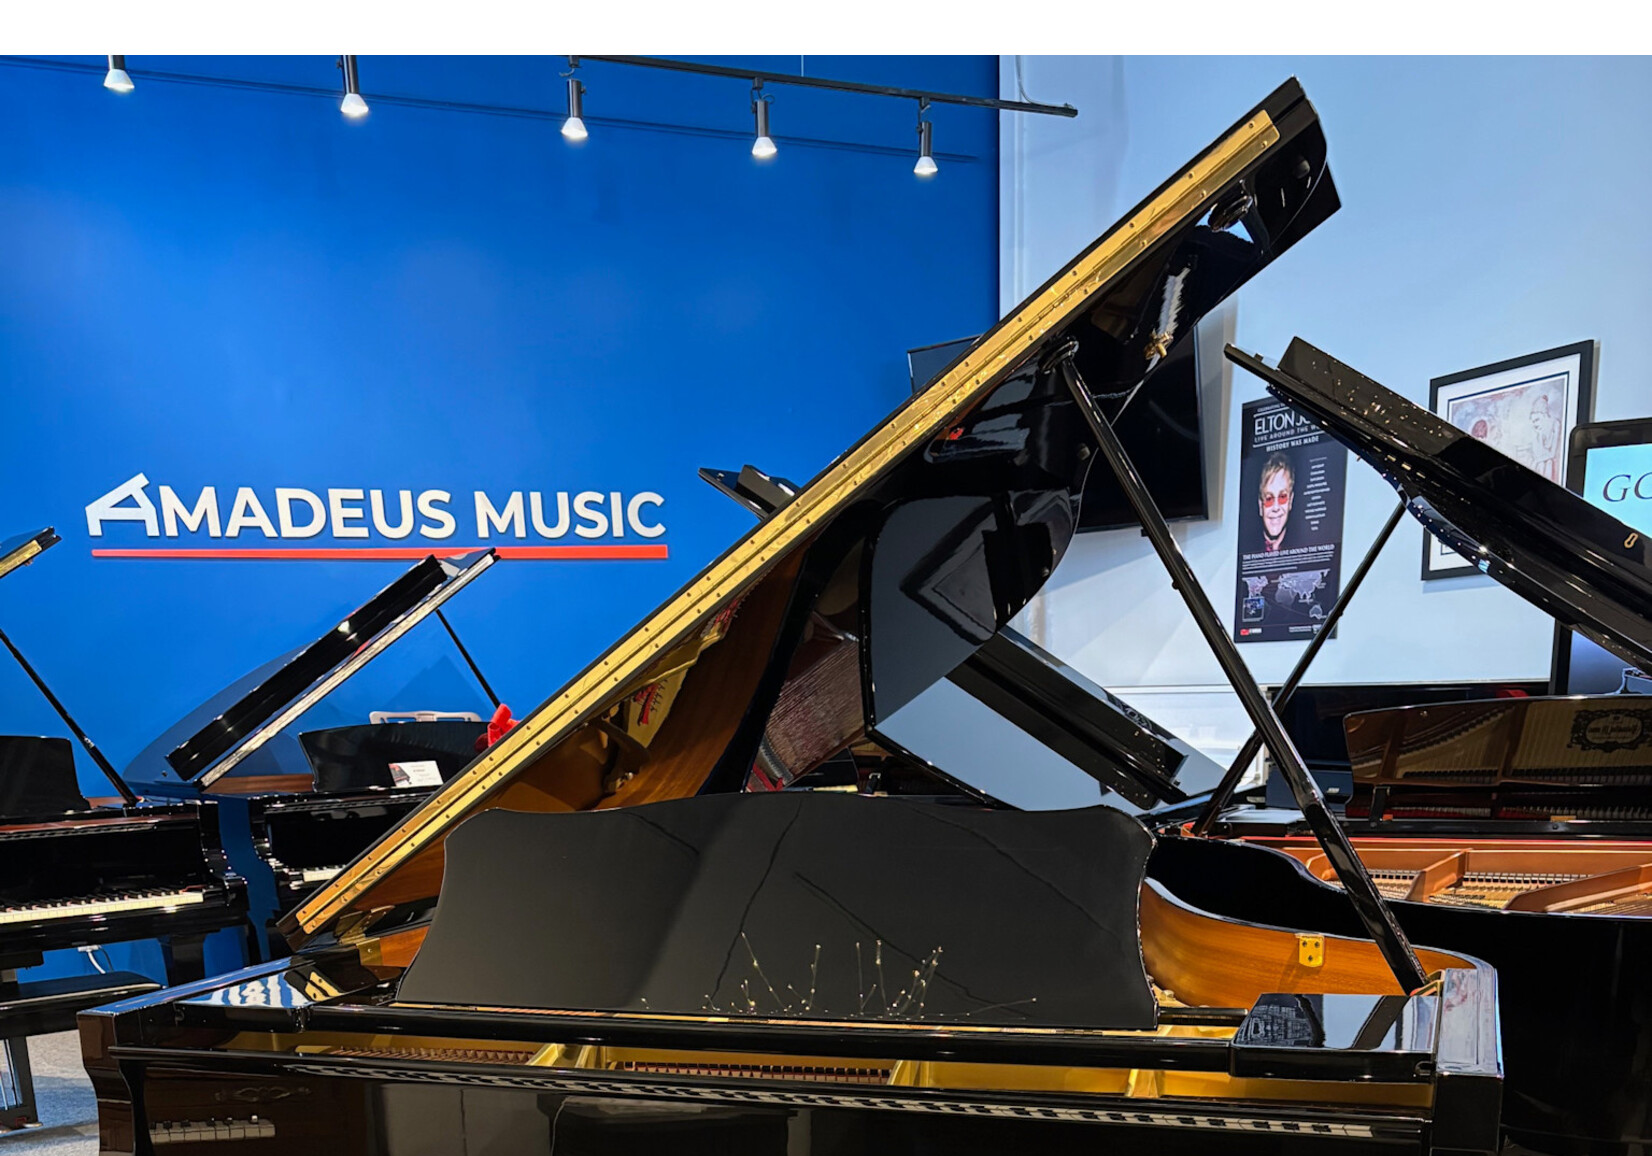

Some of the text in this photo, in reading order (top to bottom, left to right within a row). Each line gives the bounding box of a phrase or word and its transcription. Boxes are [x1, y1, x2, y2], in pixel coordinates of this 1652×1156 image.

[1255, 411, 1294, 435] ELTON
[1254, 435, 1268, 443] LIVE
[1269, 429, 1295, 439] AROUND
[1266, 435, 1319, 452] HISTORY WAS MADE
[85, 472, 666, 539] AMADEUS MUSIC
